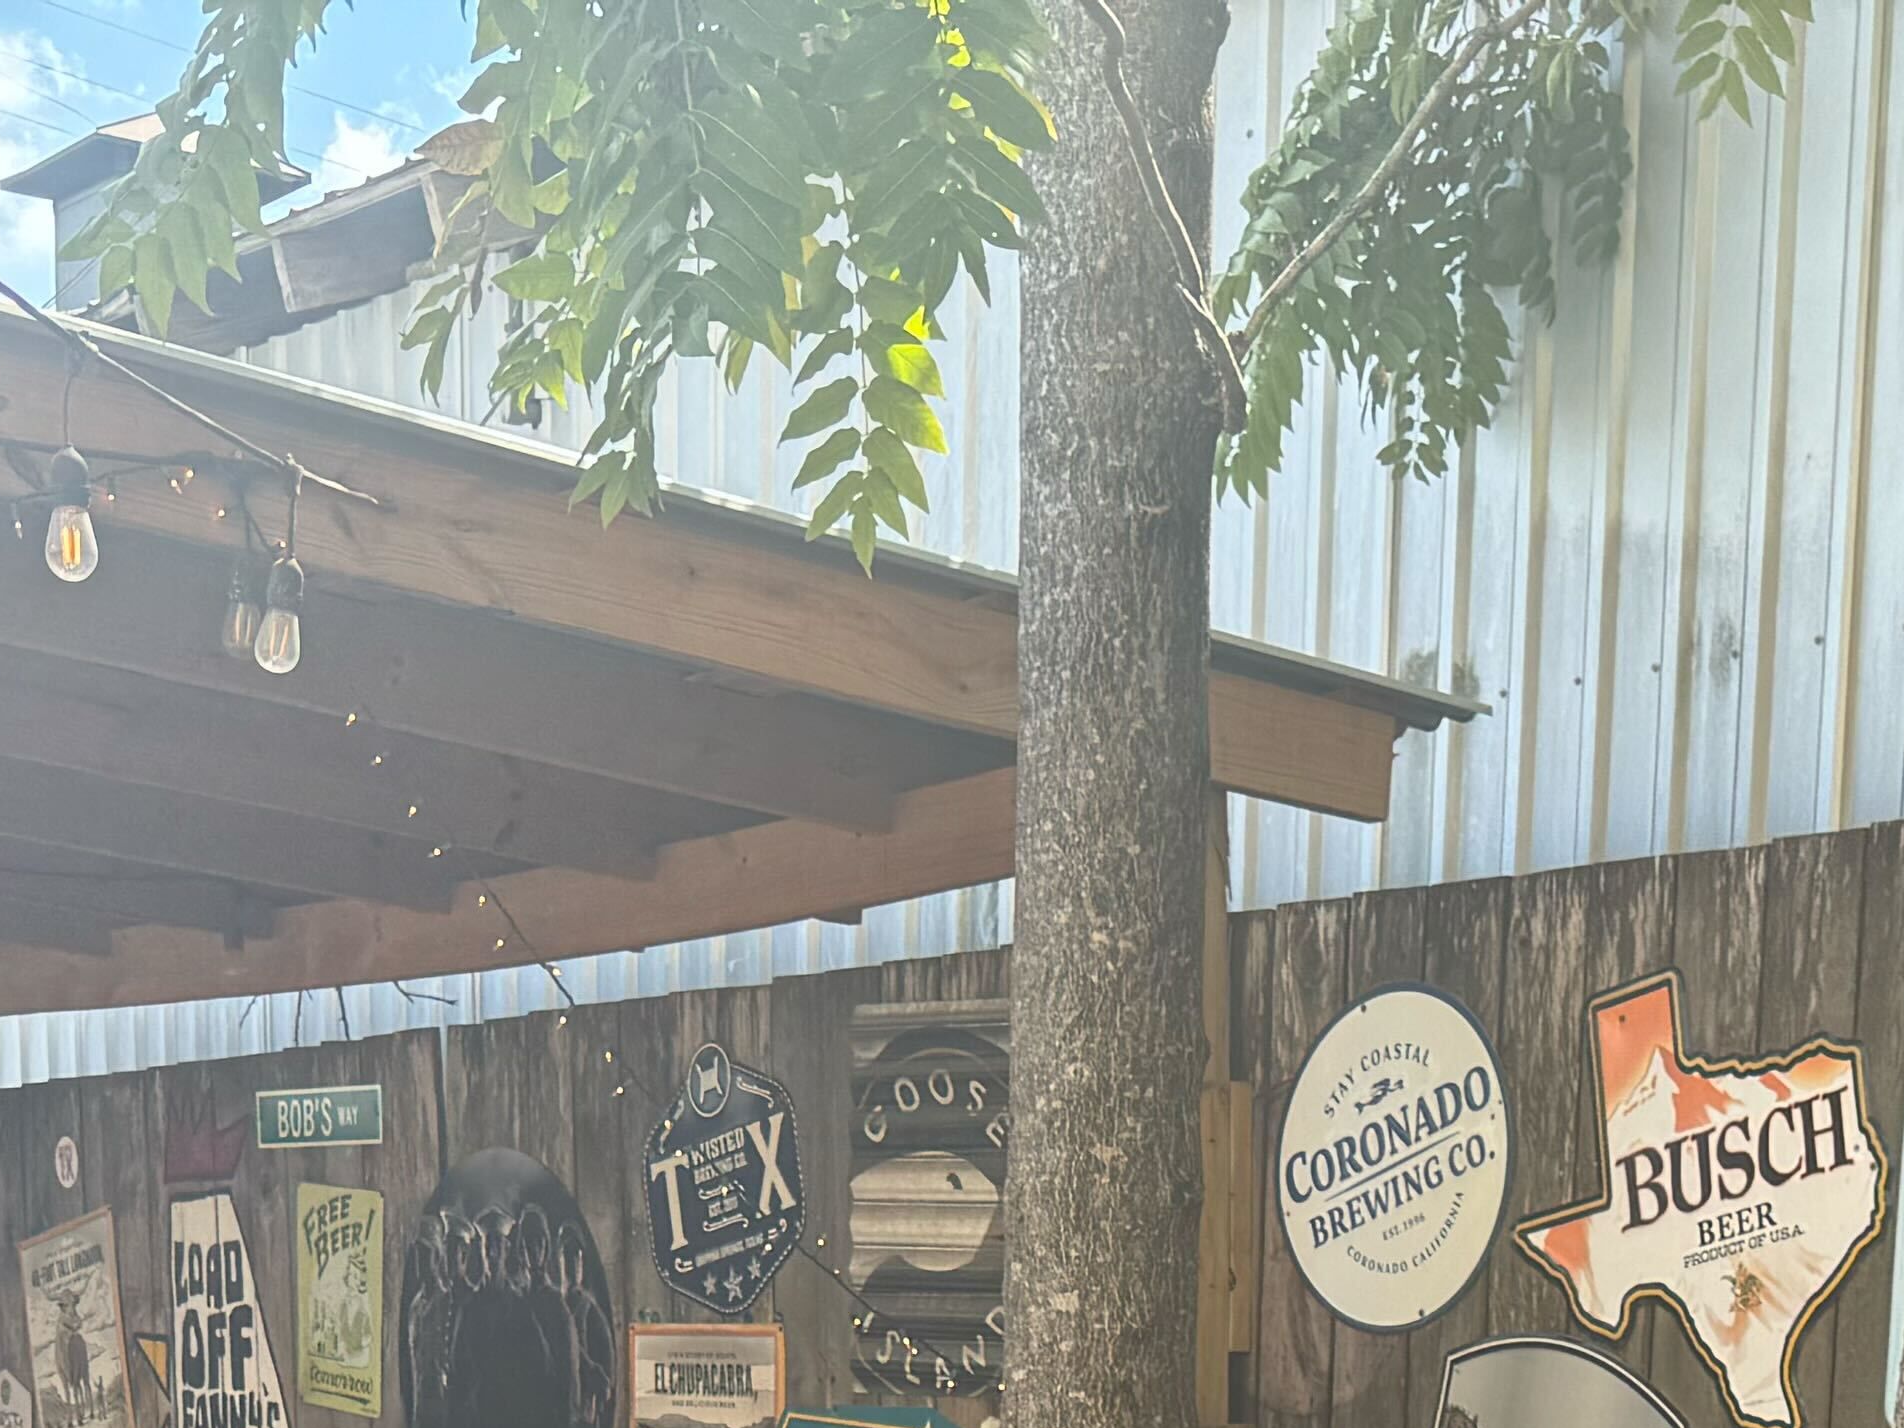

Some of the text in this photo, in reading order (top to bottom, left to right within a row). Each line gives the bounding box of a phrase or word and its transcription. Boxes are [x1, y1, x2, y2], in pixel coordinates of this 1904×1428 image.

[278, 1097, 359, 1138] BOB'S WAY
[1323, 1043, 1432, 1119] STAY COASTAL
[1284, 1066, 1493, 1203] CORONADO
[1615, 1086, 1856, 1233] BUSCH
[303, 1193, 353, 1255] FREE
[1308, 1135, 1497, 1250] BREWING CO.
[1696, 1200, 1777, 1249] BEER
[314, 1208, 376, 1281] BEER!
[1345, 1191, 1465, 1275] CORONADO CALIFORNIA
[1682, 1235, 1741, 1269] PRODUCT
[1742, 1231, 1765, 1255] OF
[173, 1239, 245, 1310] LOAD
[181, 1303, 254, 1392] OFF
[654, 1363, 758, 1401] EL CHUPACABRA,
